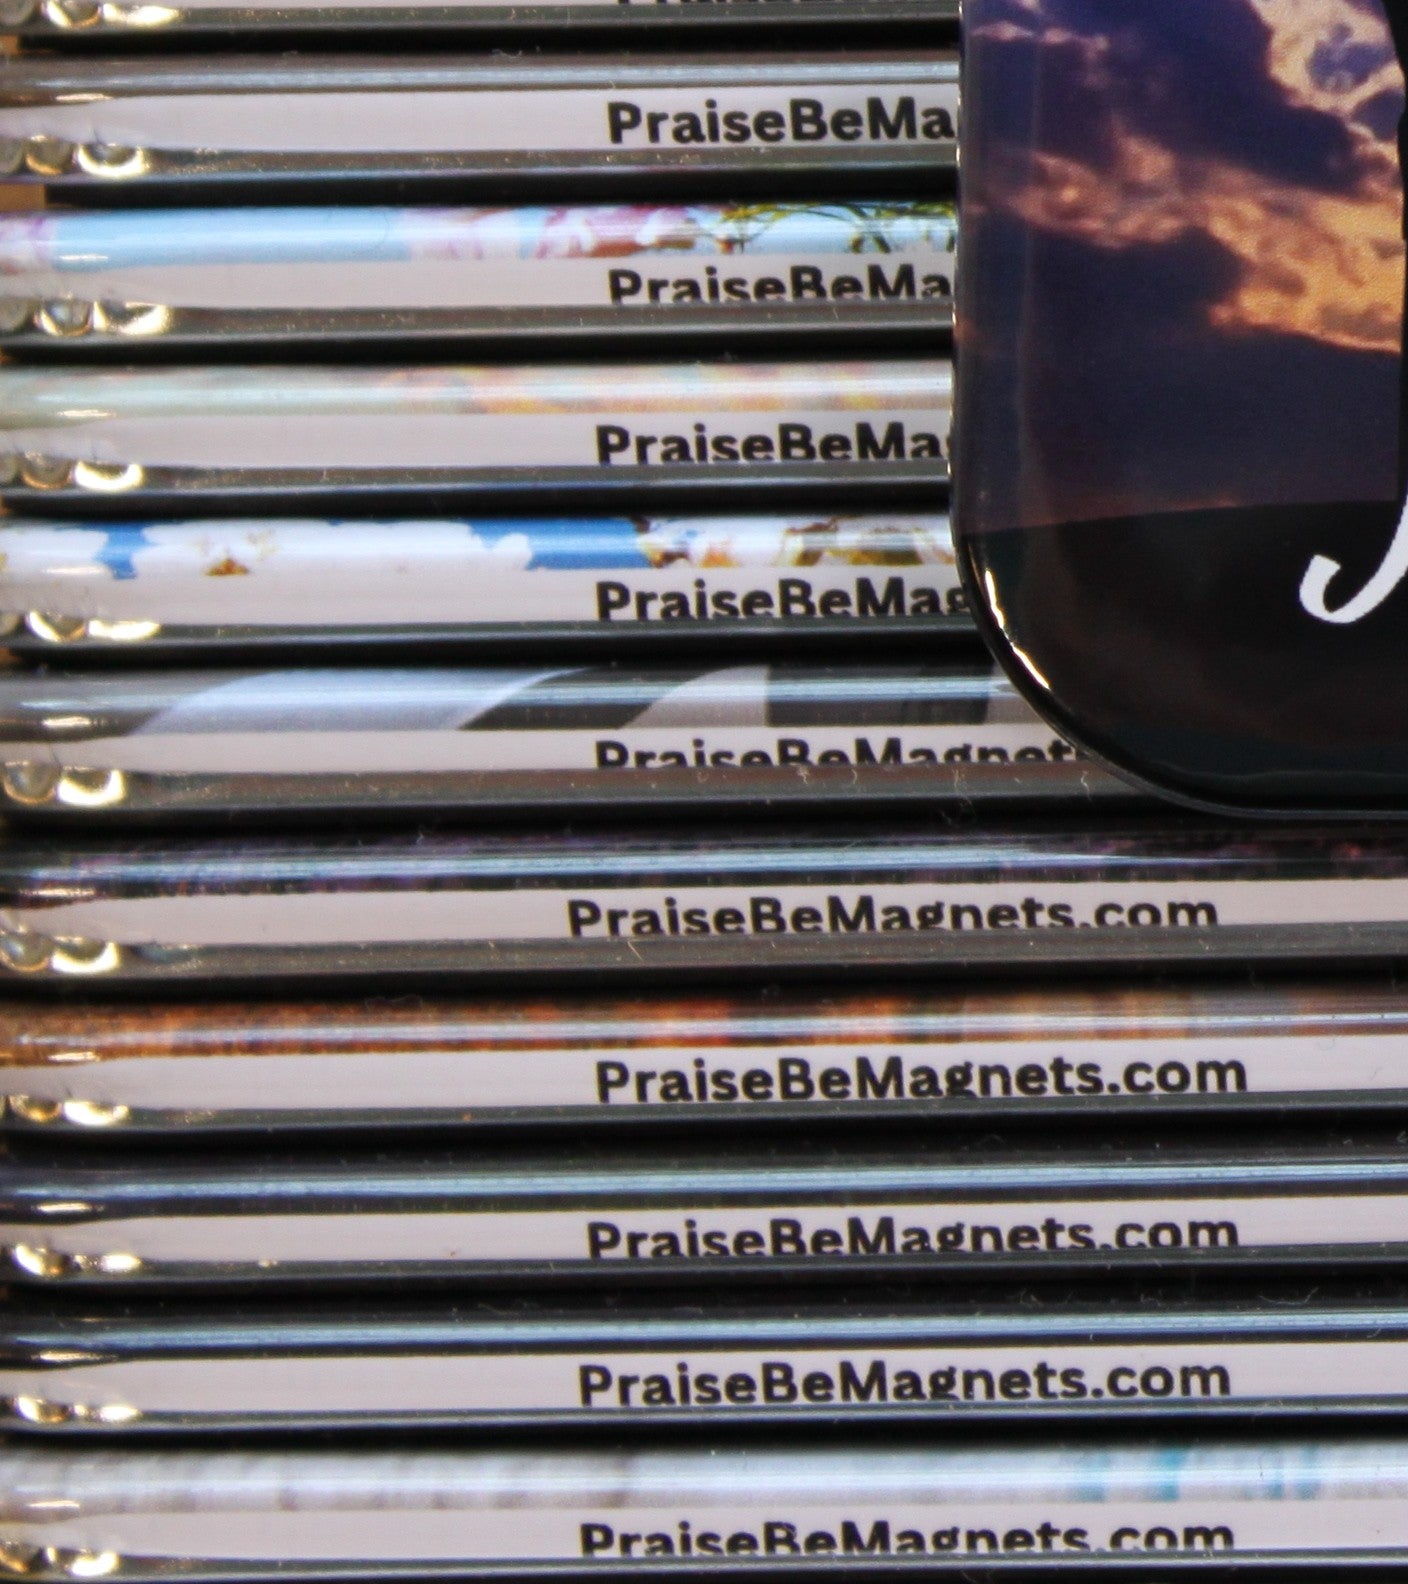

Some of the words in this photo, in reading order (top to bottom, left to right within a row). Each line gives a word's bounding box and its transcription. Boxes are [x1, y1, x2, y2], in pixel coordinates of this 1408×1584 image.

[607, 97, 957, 144] PraiseBeMa
[608, 265, 951, 306] PraiseBeMa
[596, 422, 951, 466] PraiseBeMa
[567, 895, 1219, 939] PraiseBeMagnets.com
[596, 1055, 1248, 1104] PraiseBeMagnets.com
[586, 1217, 1240, 1259] PraiseBeMagnets.com
[577, 1361, 1231, 1406] PraiseBeMagnets.com
[579, 1519, 1235, 1557] PraiseBeMagnetscom
